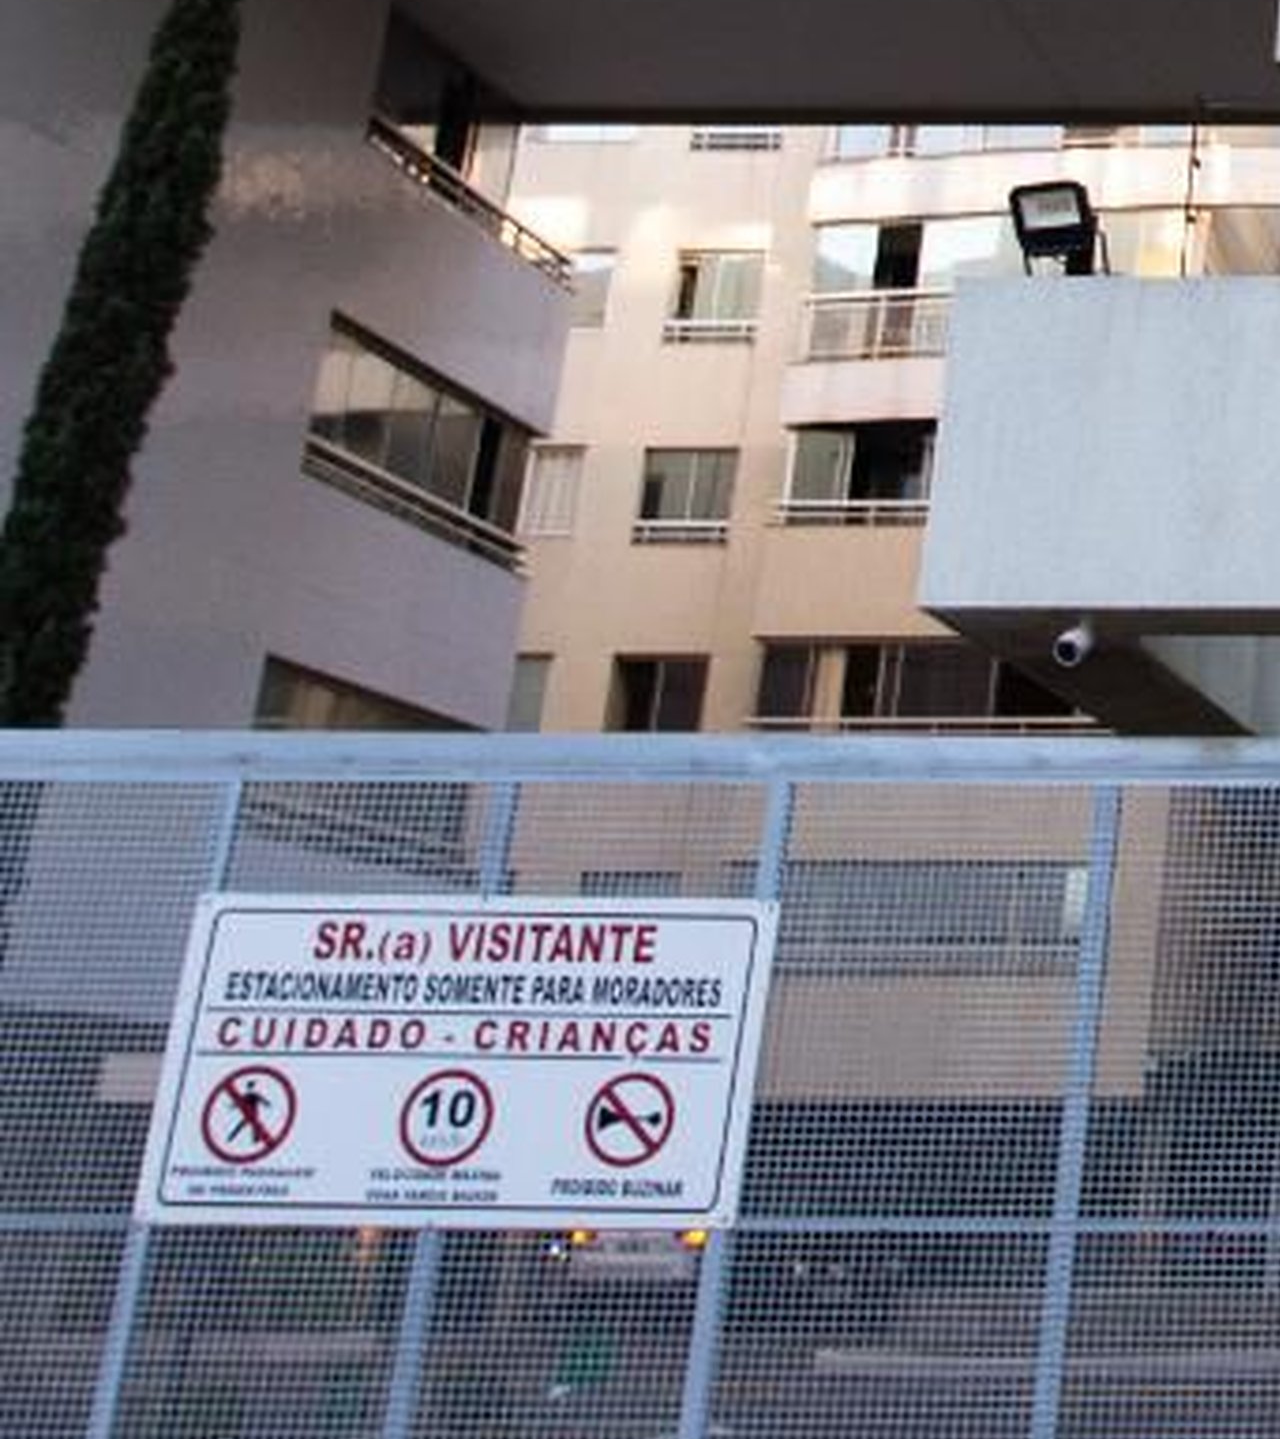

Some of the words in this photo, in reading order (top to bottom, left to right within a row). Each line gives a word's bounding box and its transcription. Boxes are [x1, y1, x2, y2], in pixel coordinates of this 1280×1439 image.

[313, 920, 432, 964] SR.(a)
[449, 922, 658, 964] VISITANTE
[224, 970, 417, 1002] ESTACIONAMENTO
[423, 972, 525, 1005] SOMENTE
[531, 974, 584, 1006] PARA
[592, 976, 722, 1008] MORADORES
[217, 1017, 426, 1049] CUIDADO
[474, 1020, 712, 1055] CRIANÇAS
[420, 1088, 476, 1128] 10
